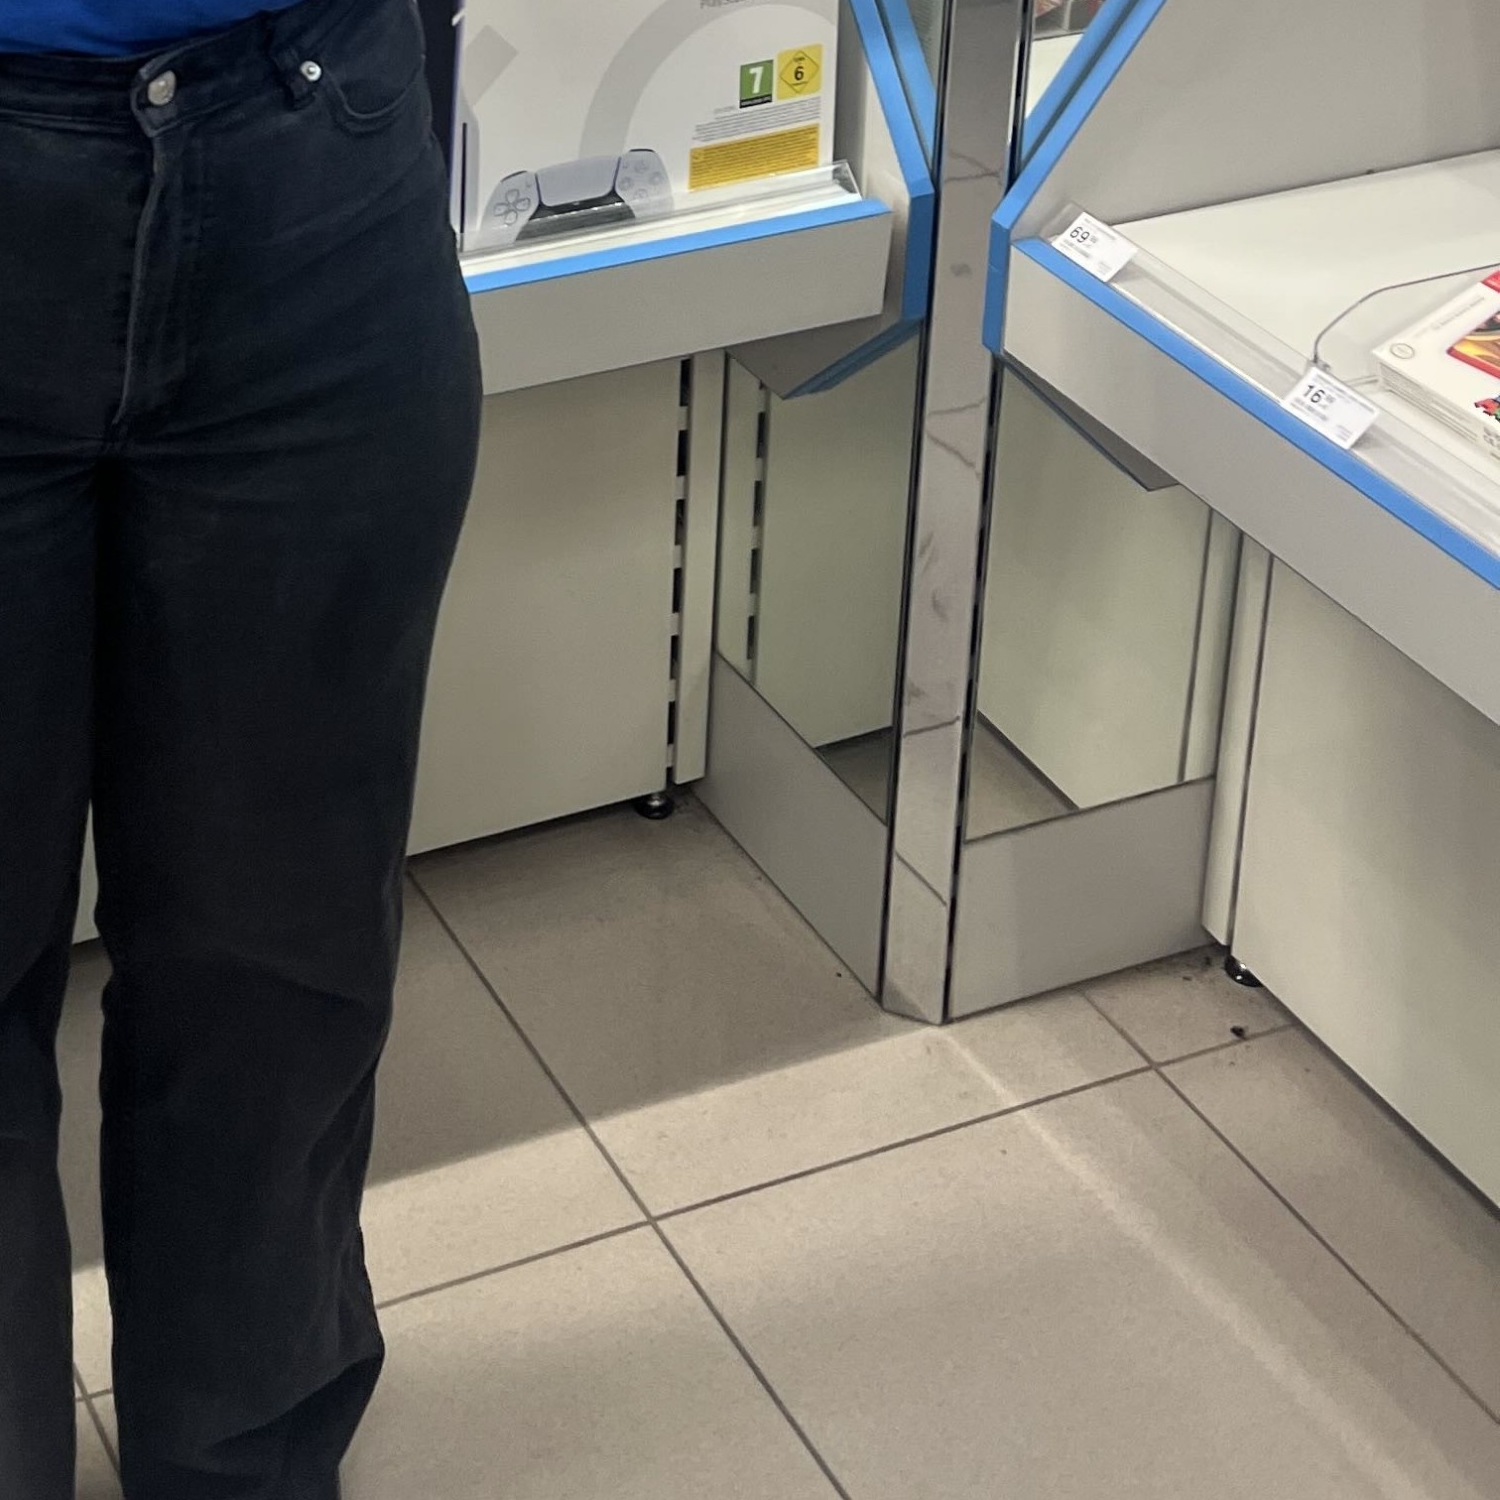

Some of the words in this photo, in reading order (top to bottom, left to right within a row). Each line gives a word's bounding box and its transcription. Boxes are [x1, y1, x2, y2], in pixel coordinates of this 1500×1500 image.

[750, 66, 764, 94] 7
[1070, 227, 1090, 243] 69
[1304, 385, 1325, 403] 16
